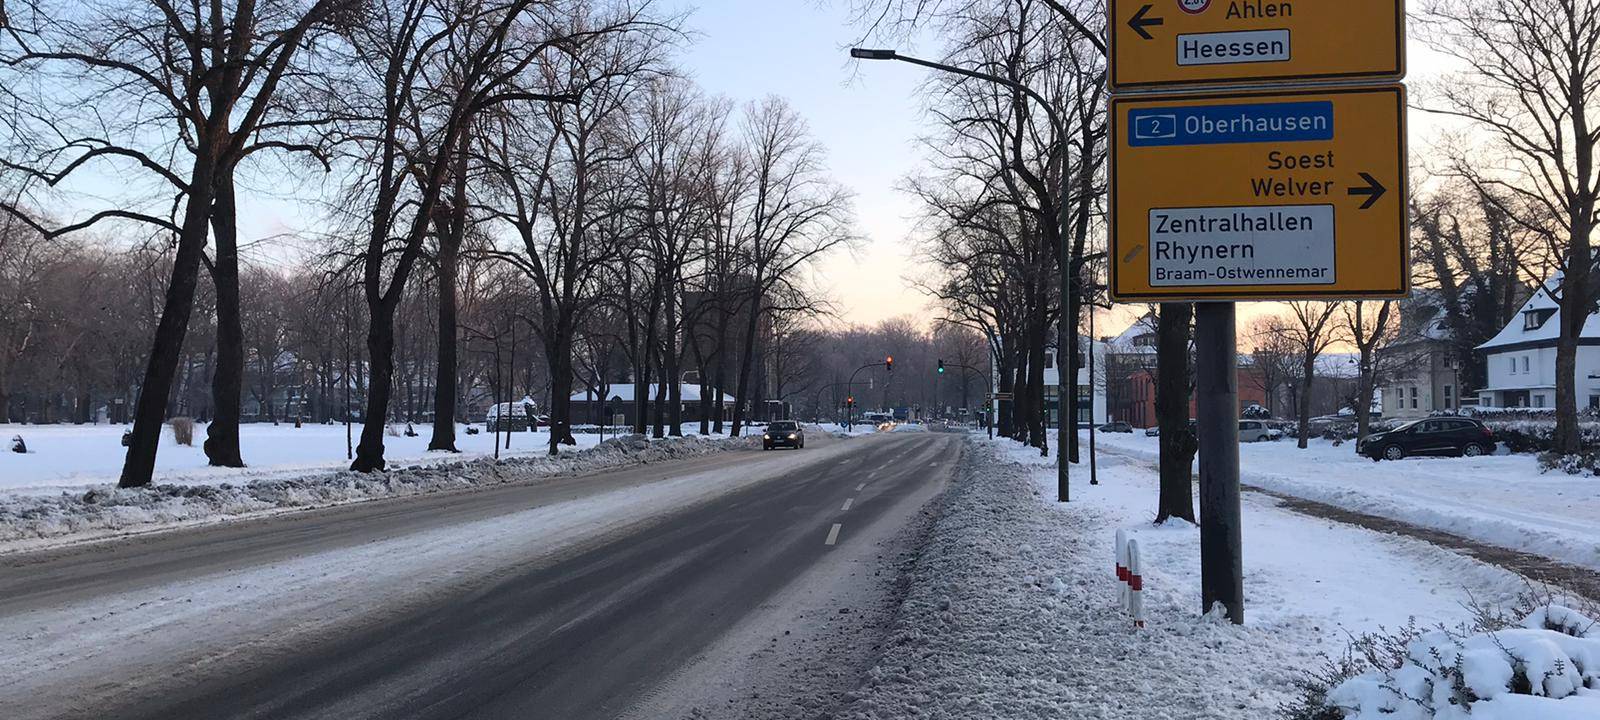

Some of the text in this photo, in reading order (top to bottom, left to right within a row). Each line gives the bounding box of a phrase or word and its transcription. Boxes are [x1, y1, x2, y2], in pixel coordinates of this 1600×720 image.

[1226, 0, 1292, 19] Ahlen
[1183, 40, 1283, 58] Heessen
[1151, 114, 1326, 134] 2 Oberhausen
[1267, 151, 1334, 169] Soest
[1251, 178, 1334, 196] Welver
[1155, 212, 1313, 233] Zentralhallen
[1155, 241, 1254, 264] Rhynern
[1155, 266, 1328, 280] Braam-Ostwennemar
